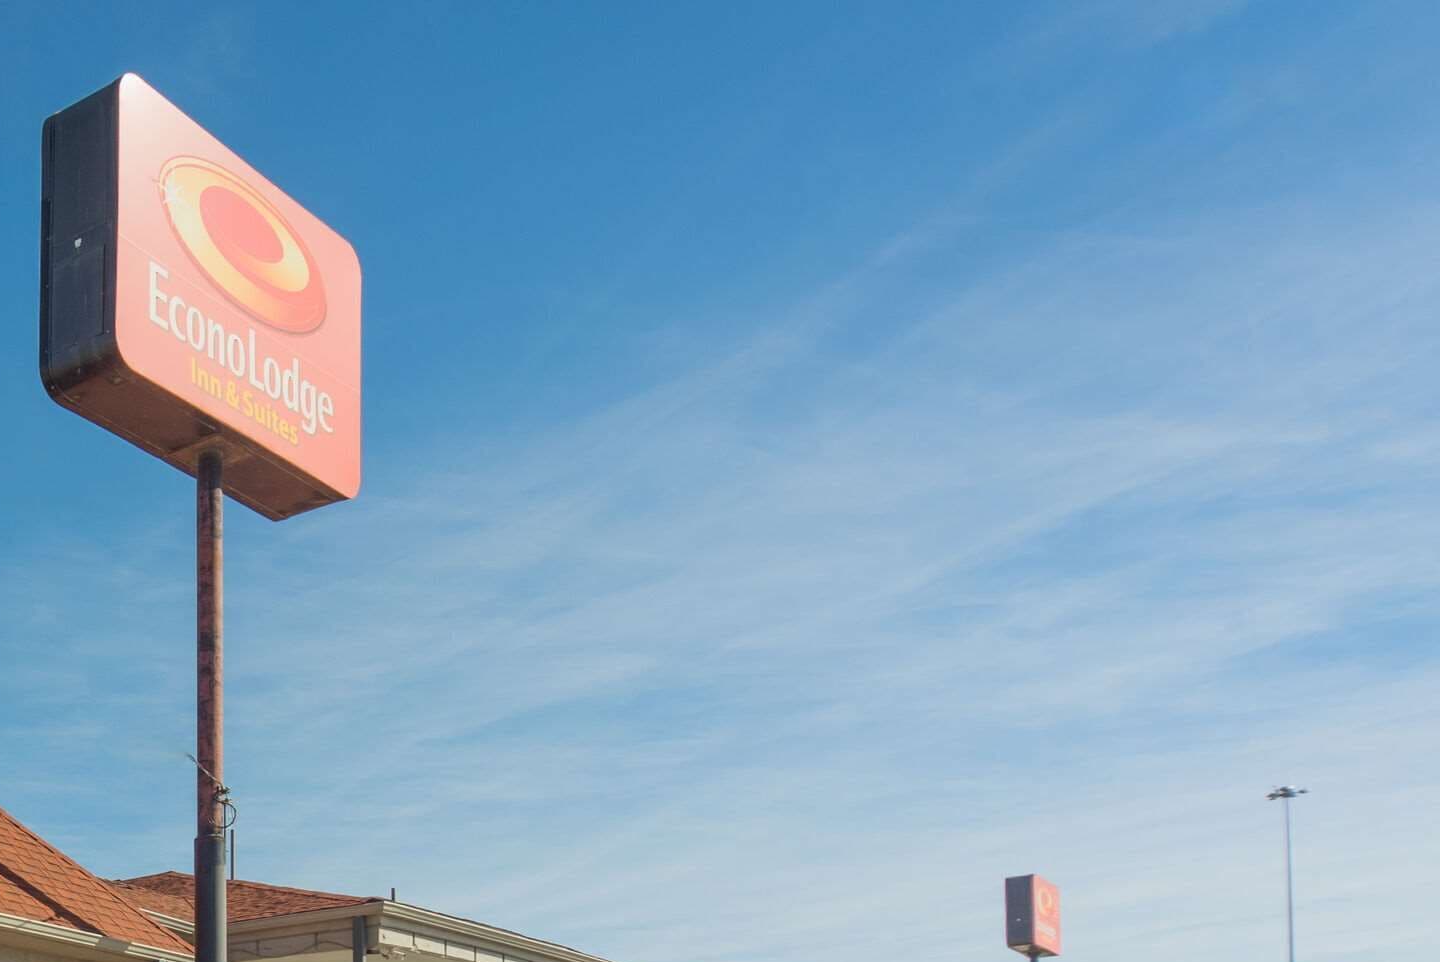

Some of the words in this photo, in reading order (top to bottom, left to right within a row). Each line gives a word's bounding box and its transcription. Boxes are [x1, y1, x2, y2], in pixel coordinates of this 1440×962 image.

[148, 260, 334, 435] EconoLodge
[191, 356, 222, 399] Inn
[225, 380, 240, 410] &
[243, 390, 299, 446] Suites
